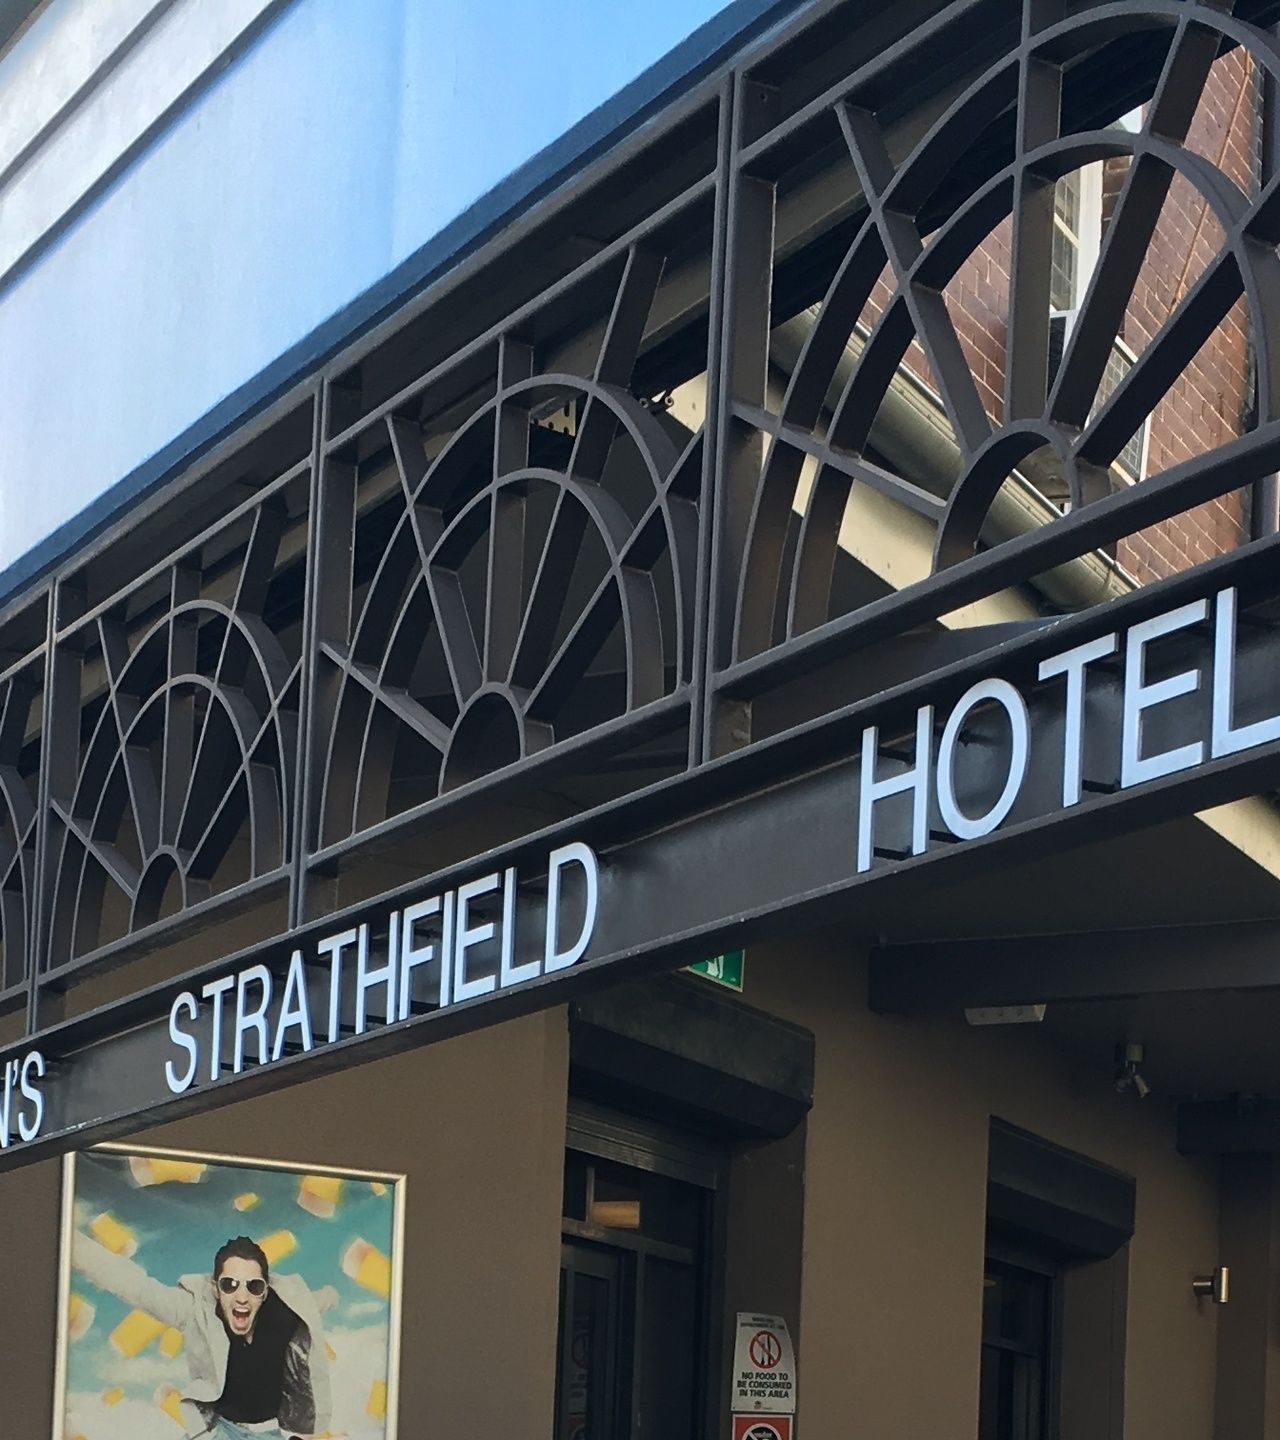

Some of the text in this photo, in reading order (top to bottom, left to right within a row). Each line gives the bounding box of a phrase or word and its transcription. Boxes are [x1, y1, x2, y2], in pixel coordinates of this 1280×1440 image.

[165, 841, 600, 1094] STRATHFIELD
[741, 1371, 789, 1381] NO FOOD TO
[737, 1380, 792, 1390] BE CONSUMED
[739, 1389, 789, 1399] IN THIS AREA
